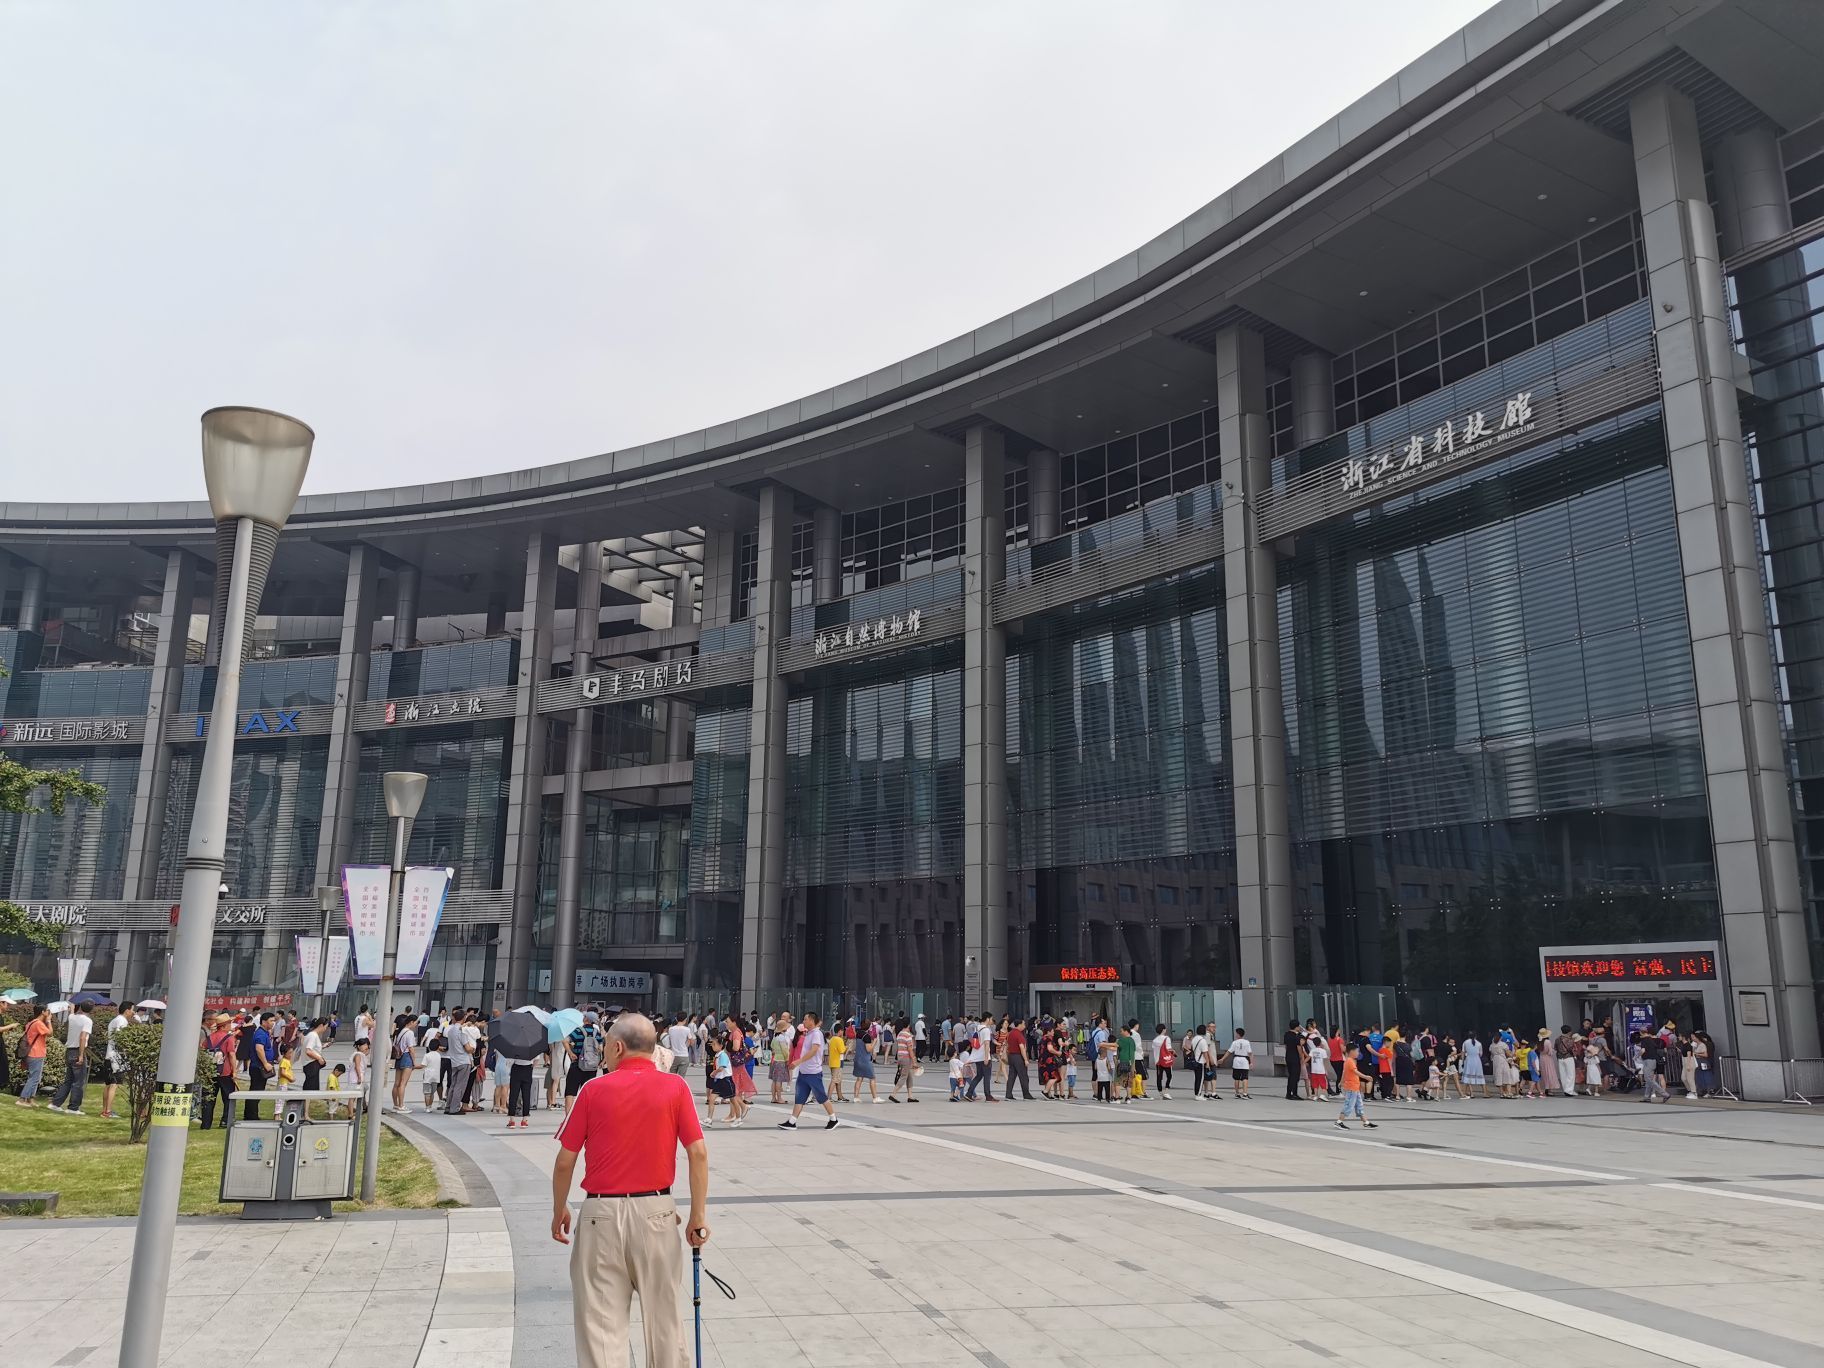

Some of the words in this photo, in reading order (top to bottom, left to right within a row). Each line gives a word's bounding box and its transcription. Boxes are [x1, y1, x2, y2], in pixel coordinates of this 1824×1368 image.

[1350, 482, 1384, 499] ZHEJIANG
[1388, 469, 1417, 485] SCIENCE
[1421, 460, 1438, 472] AND
[1443, 439, 1493, 463] TECHNOLOGY
[1497, 423, 1535, 443] MUSEUM
[609, 662, 692, 695] 丰马剧场
[13, 722, 54, 742] 新远
[59, 720, 129, 741] 国际影城
[195, 711, 301, 738] IAX
[219, 905, 266, 924] 文交所
[590, 975, 645, 988] 广场执勤岗亭
[163, 1083, 186, 1094] 警示
[153, 1095, 192, 1105] 明设施带
